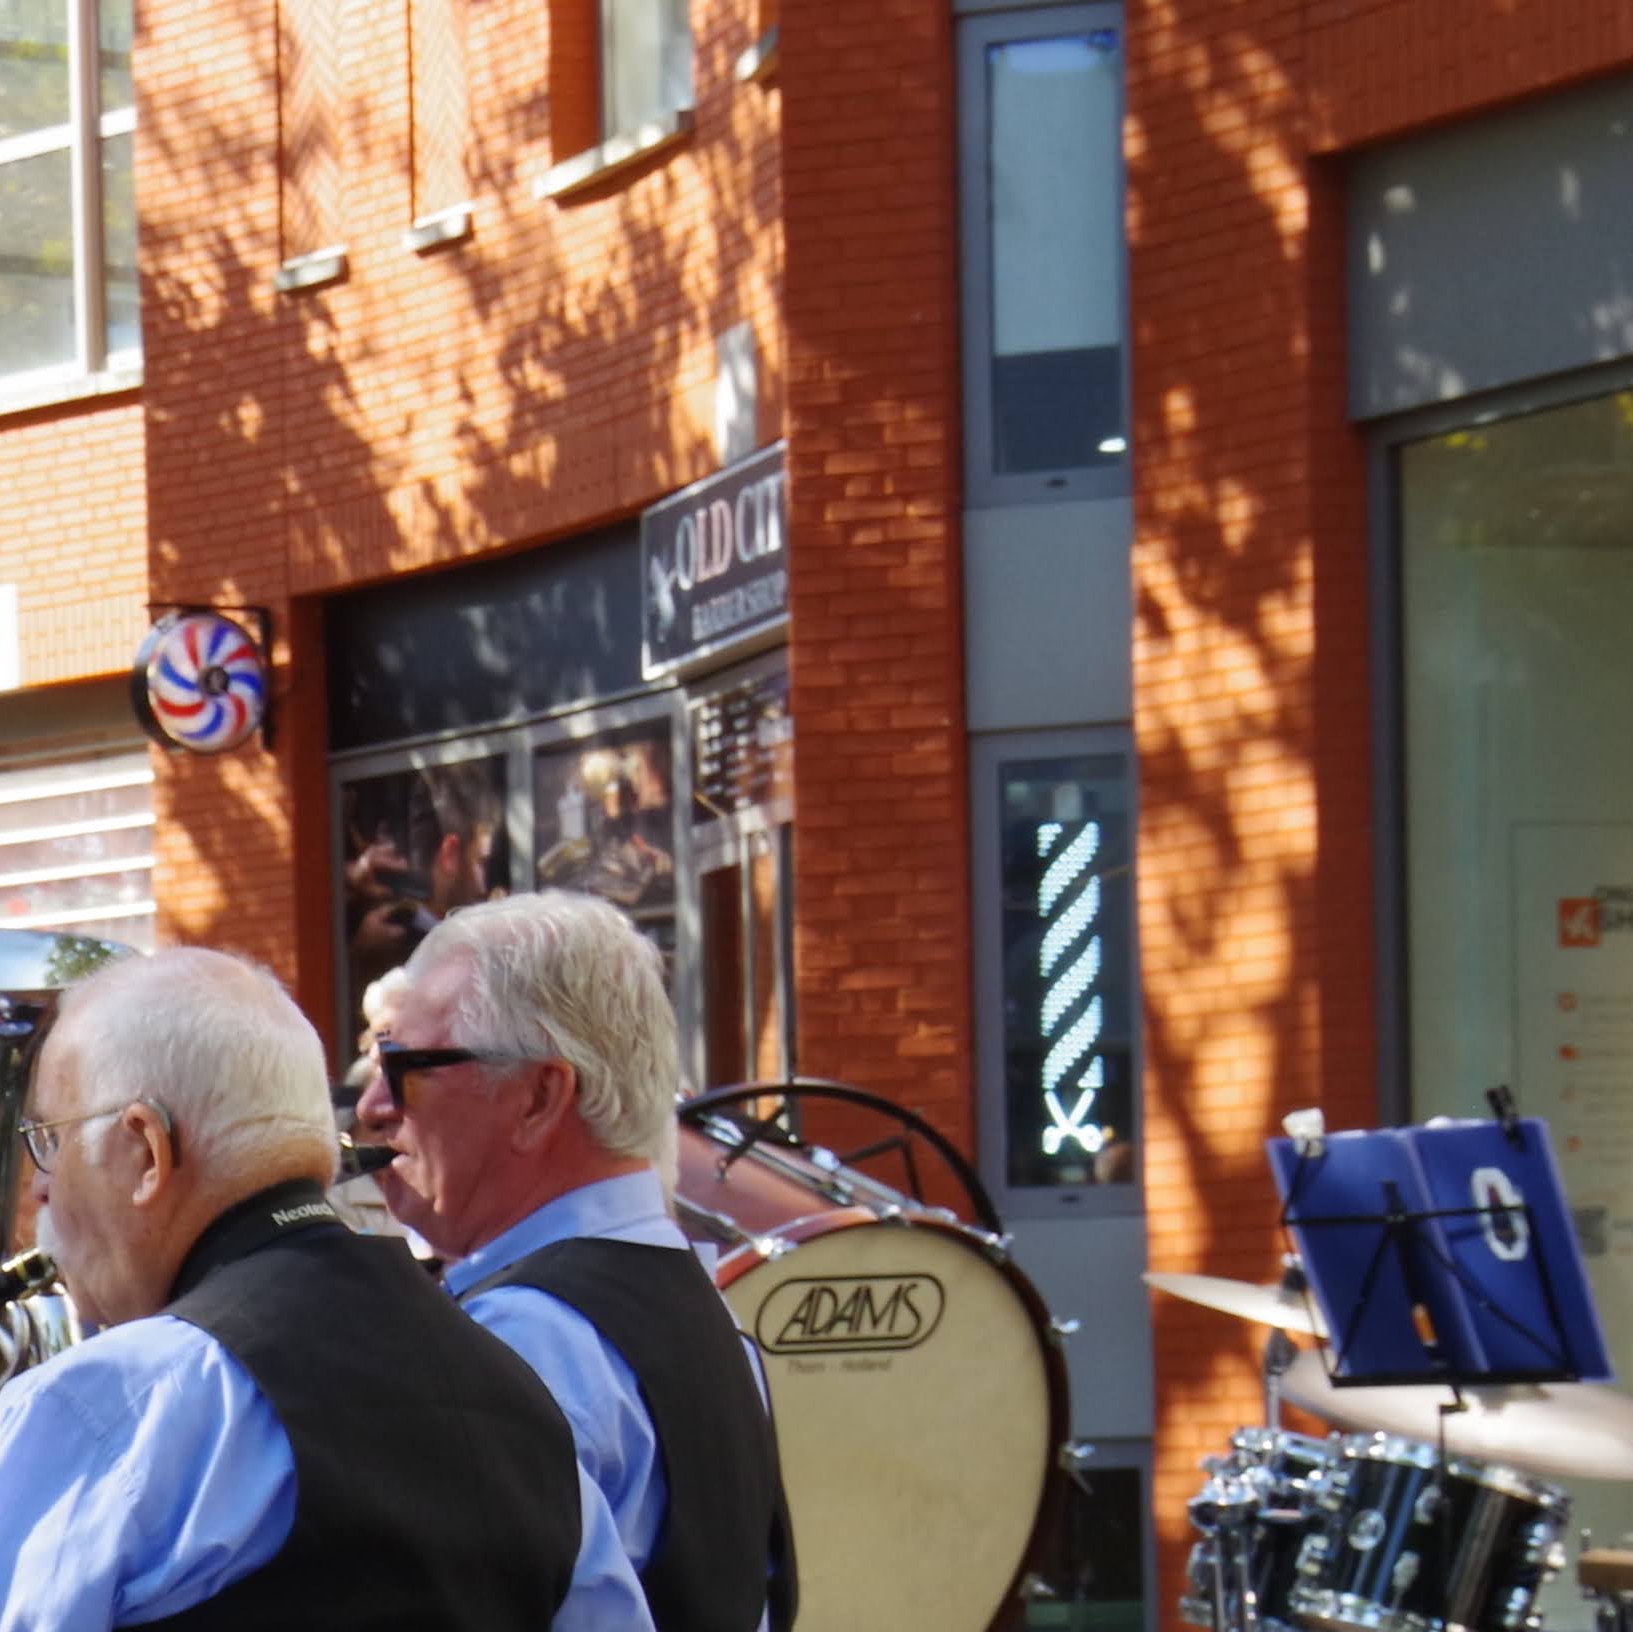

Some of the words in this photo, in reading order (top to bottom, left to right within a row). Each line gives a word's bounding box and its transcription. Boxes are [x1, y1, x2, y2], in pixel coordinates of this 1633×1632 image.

[676, 498, 734, 591] OLD
[736, 471, 789, 563] CIT
[775, 1283, 922, 1345] ADAMS
